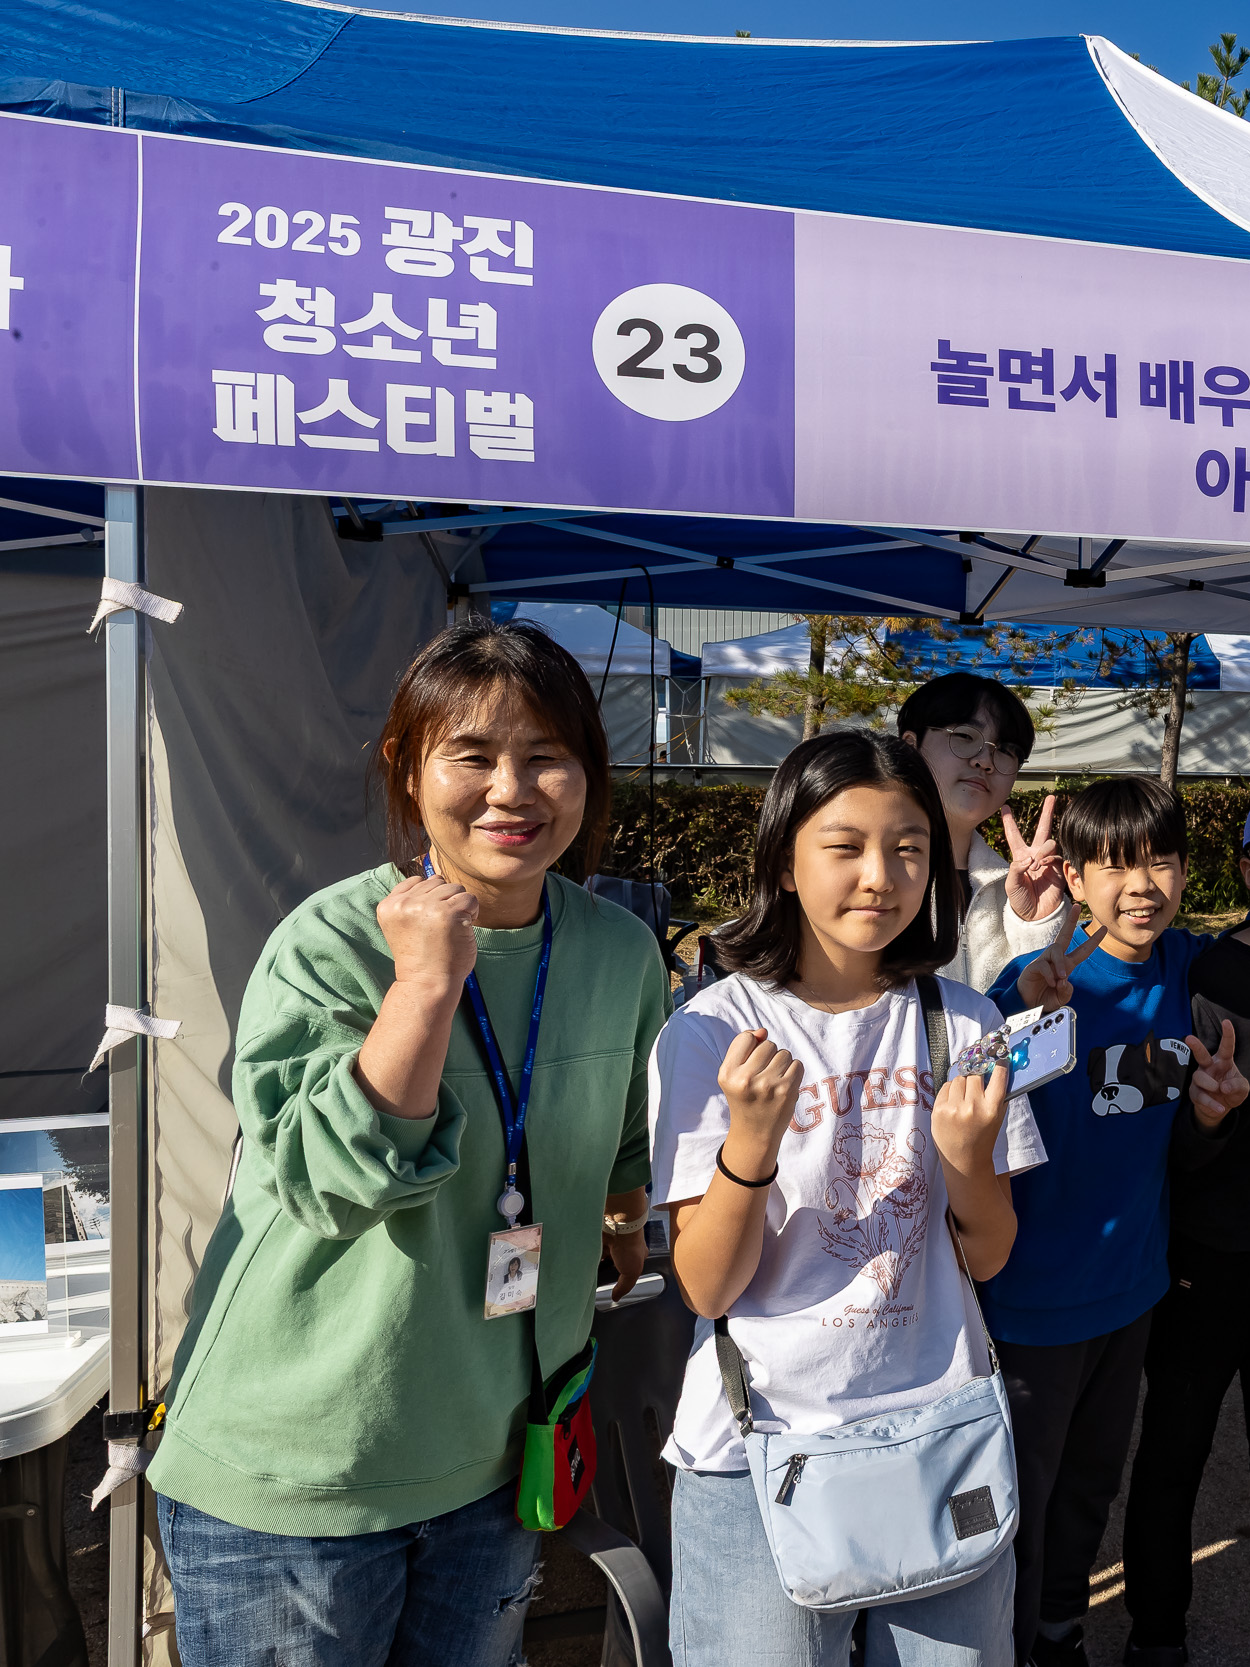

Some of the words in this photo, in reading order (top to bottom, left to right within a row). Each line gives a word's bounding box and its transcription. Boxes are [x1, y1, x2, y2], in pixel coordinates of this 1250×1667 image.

[217, 201, 361, 256] 2025
[381, 206, 535, 287] 광진
[255, 279, 498, 370] 청소년
[616, 318, 723, 384] 23
[211, 369, 536, 463] 페스티벌
[930, 338, 1118, 419] 놀면서
[788, 1065, 936, 1134] GUESS
[822, 1317, 855, 1329] LOS
[843, 1304, 870, 1316] Guess
